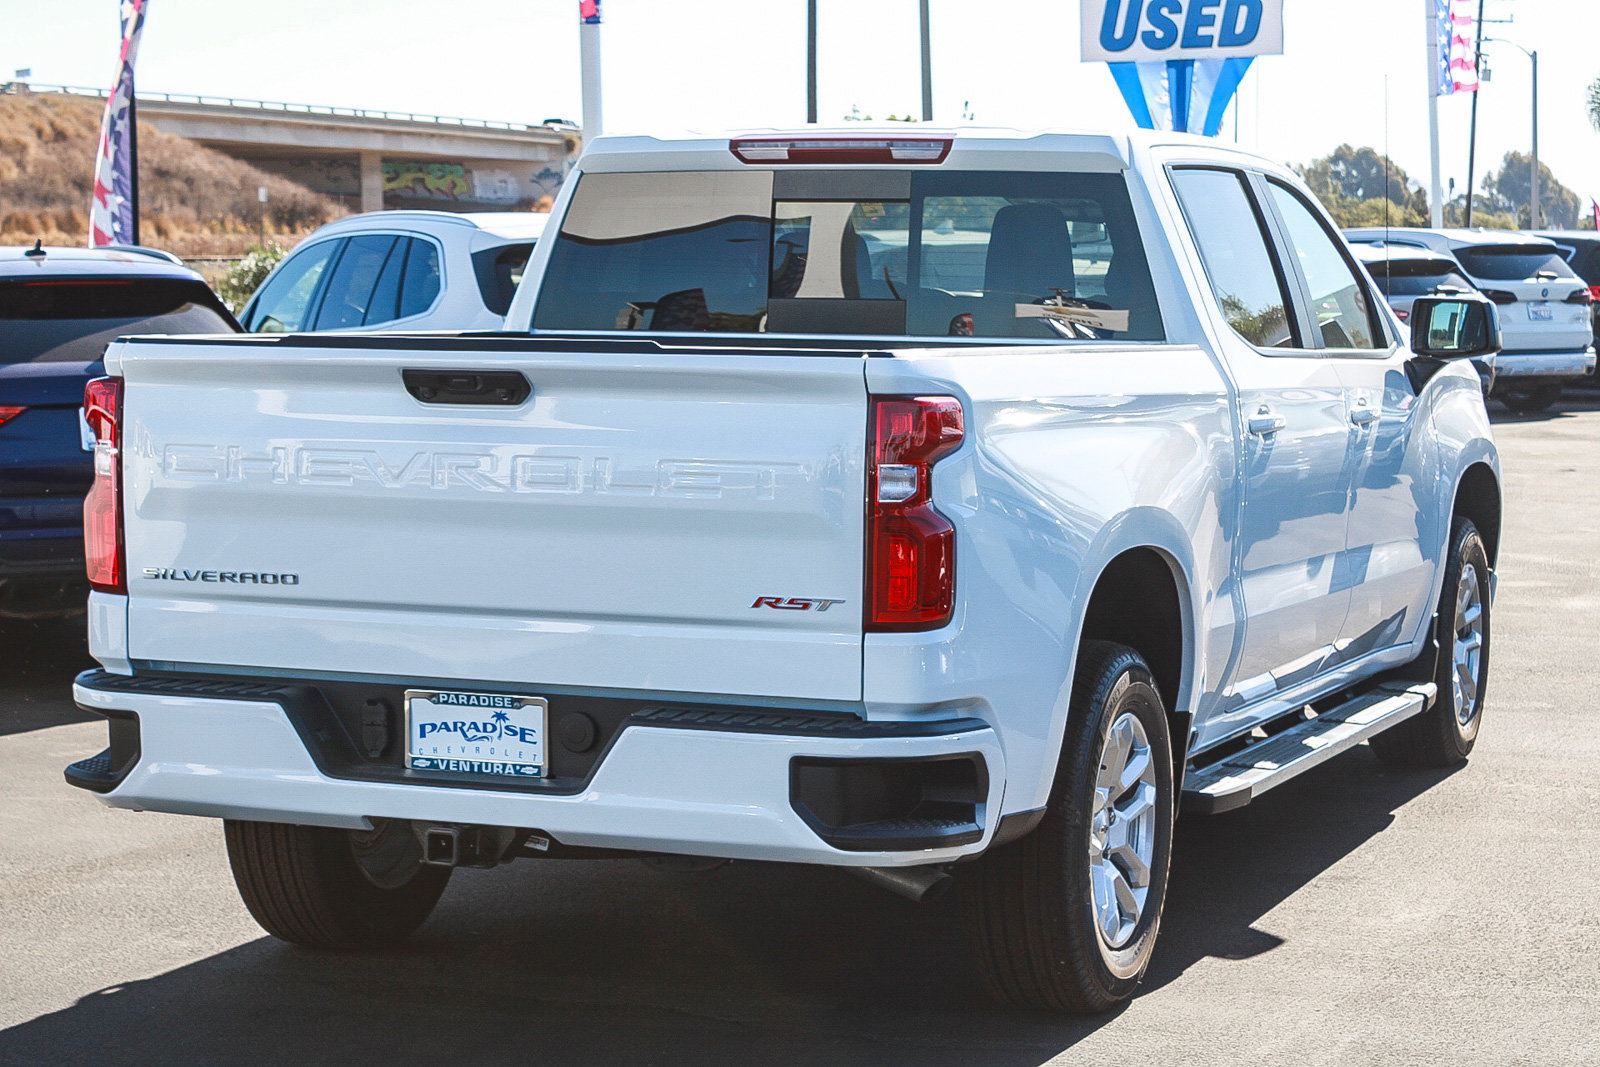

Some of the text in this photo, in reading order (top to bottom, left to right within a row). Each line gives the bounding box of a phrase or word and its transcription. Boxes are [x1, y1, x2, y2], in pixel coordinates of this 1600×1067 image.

[1100, 0, 1263, 52] USED
[163, 442, 803, 500] CHEVROLET
[142, 566, 299, 585] SILVERADO
[748, 595, 846, 612] RST
[438, 693, 513, 708] PARADISE
[419, 710, 538, 745] PARADISE
[418, 745, 537, 761] CHEVROLET
[437, 759, 516, 775] VENTURA
